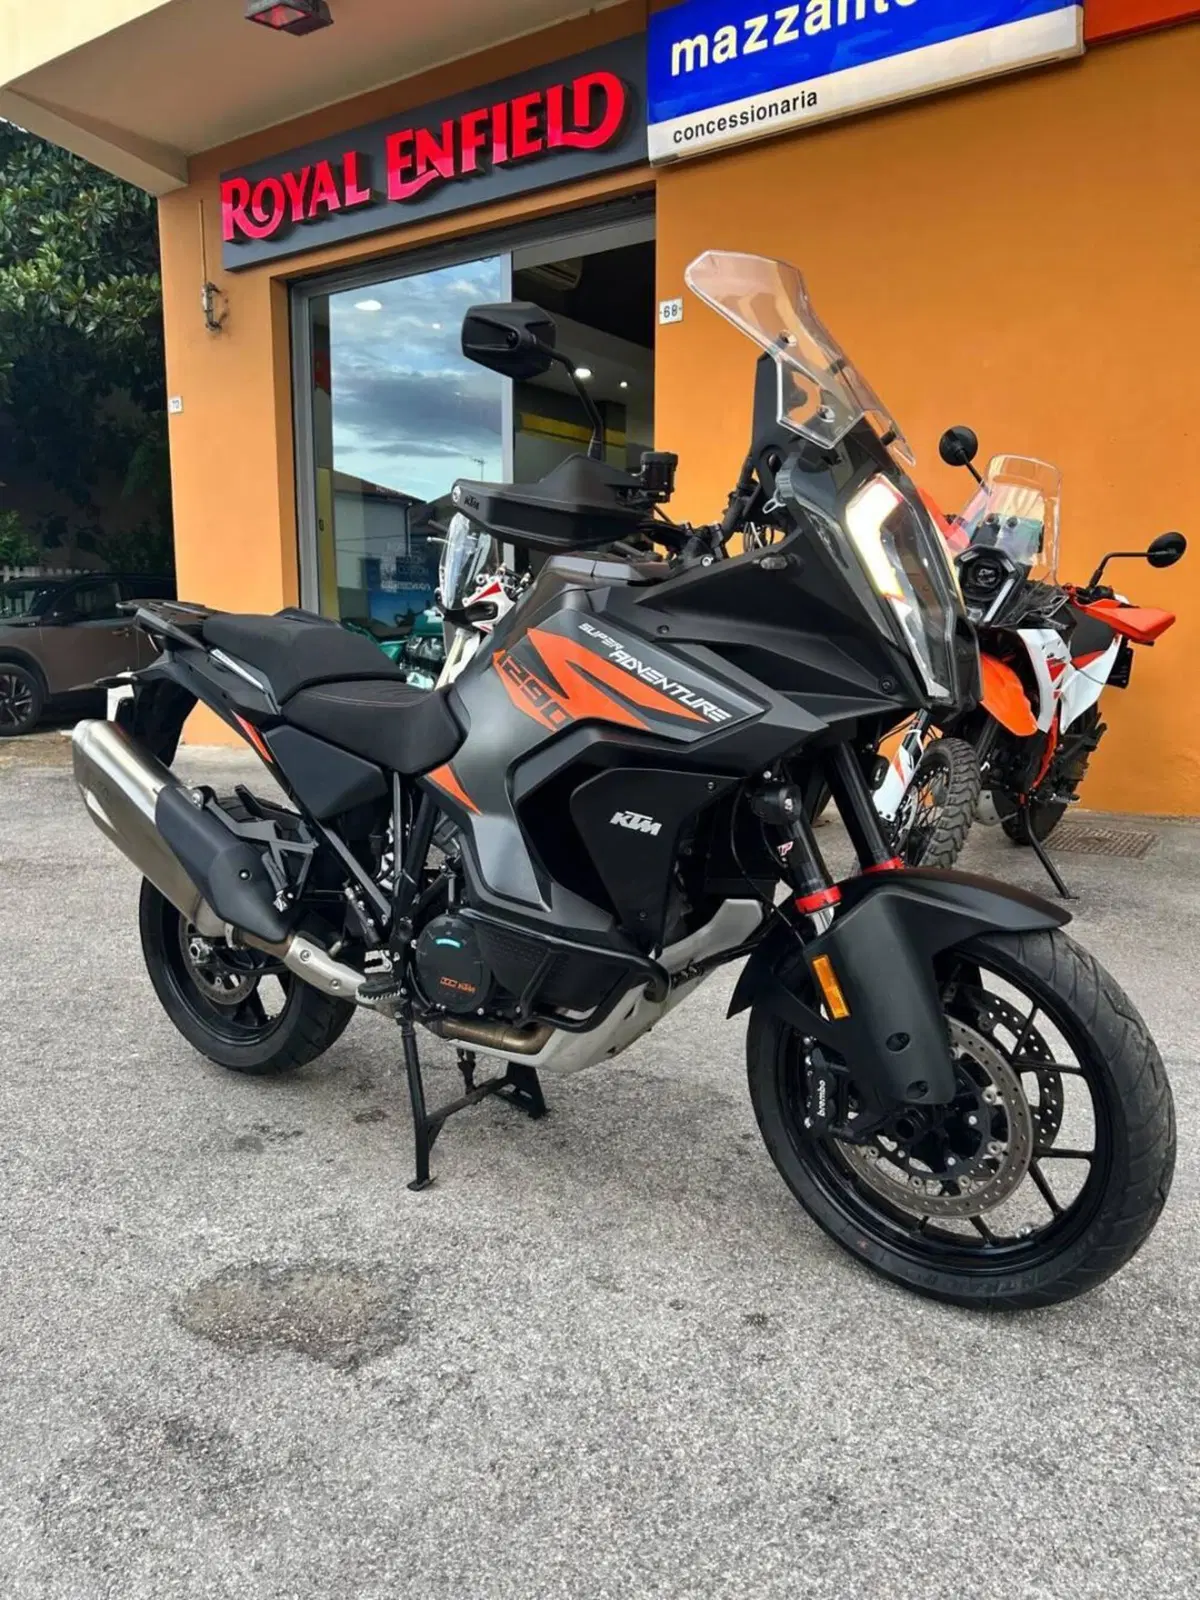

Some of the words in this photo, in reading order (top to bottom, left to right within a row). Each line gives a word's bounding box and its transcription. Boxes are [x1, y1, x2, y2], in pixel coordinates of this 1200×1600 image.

[673, 88, 818, 144] concessionaria
[220, 151, 371, 242] ROYAL
[386, 71, 625, 201] ENFIELD
[663, 304, 678, 319] 68
[578, 622, 625, 650] SUPER
[609, 649, 733, 723] ADVENTURE
[610, 810, 662, 837] KTM
[816, 1079, 826, 1117] brembo
